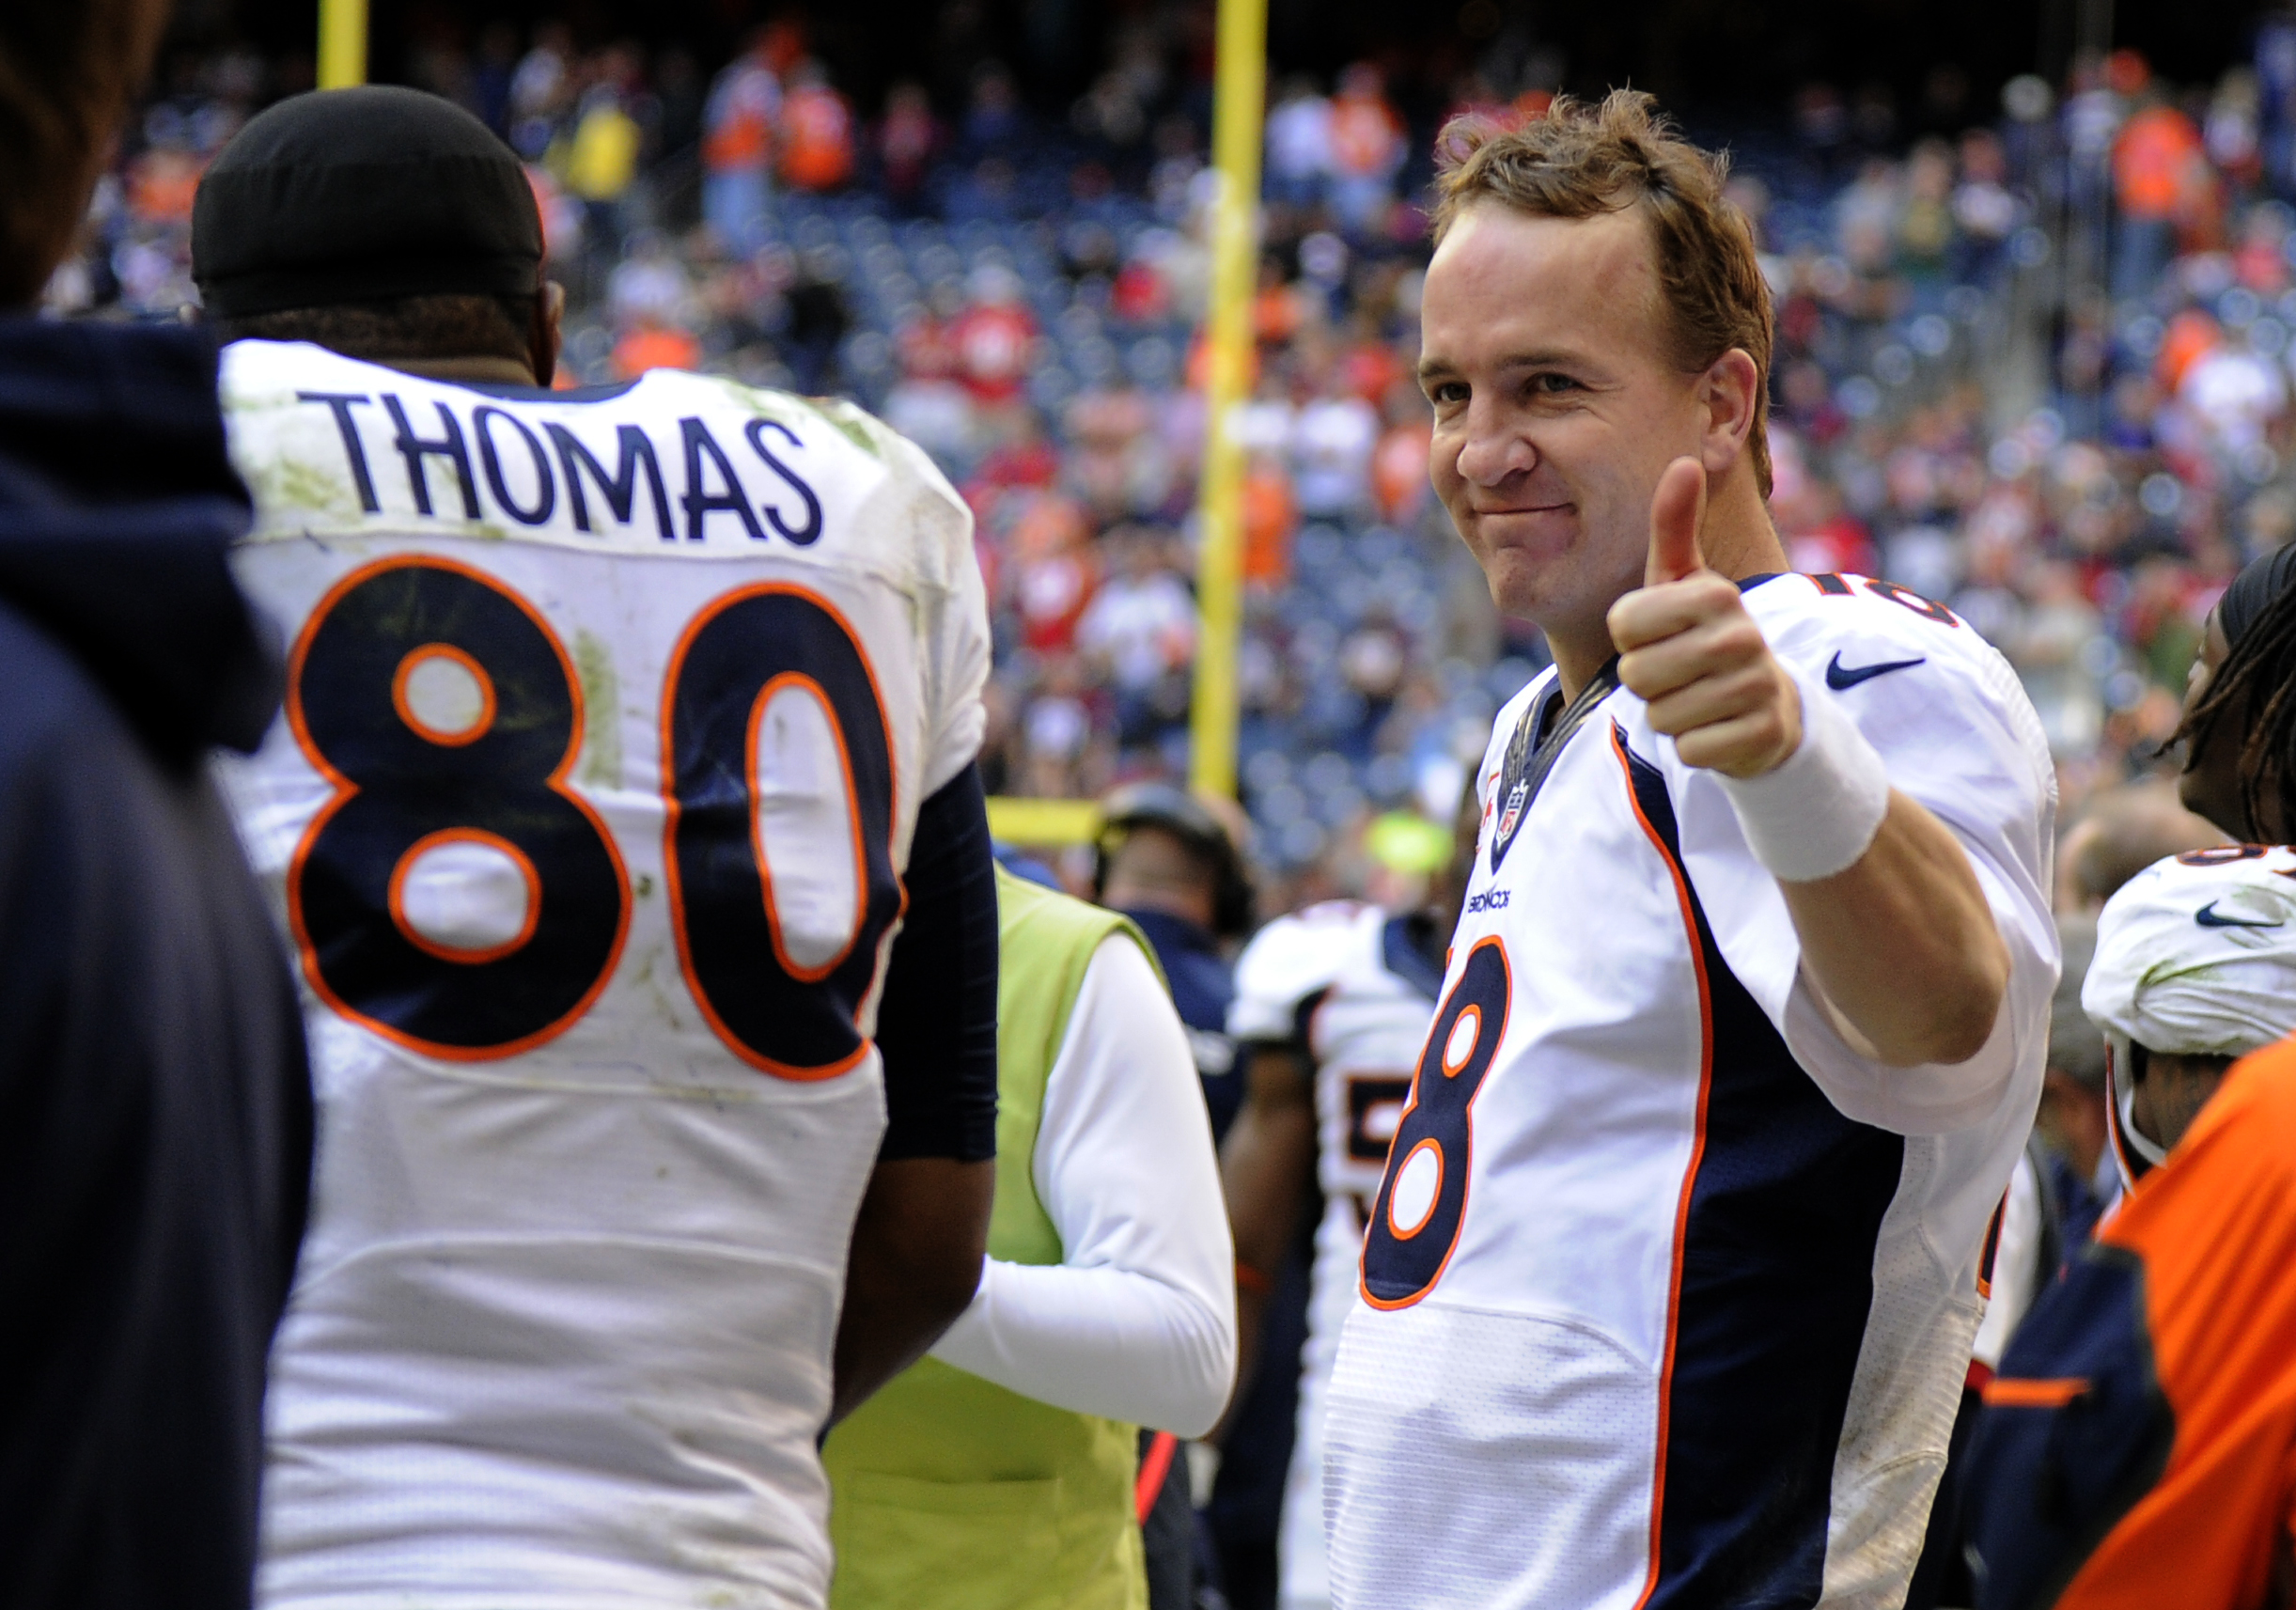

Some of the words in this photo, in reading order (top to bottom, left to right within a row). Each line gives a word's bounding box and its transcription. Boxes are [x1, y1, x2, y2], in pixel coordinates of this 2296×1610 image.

[297, 391, 822, 546] THOMAS
[285, 553, 908, 1081] 80
[1359, 934, 1512, 1310] 8
